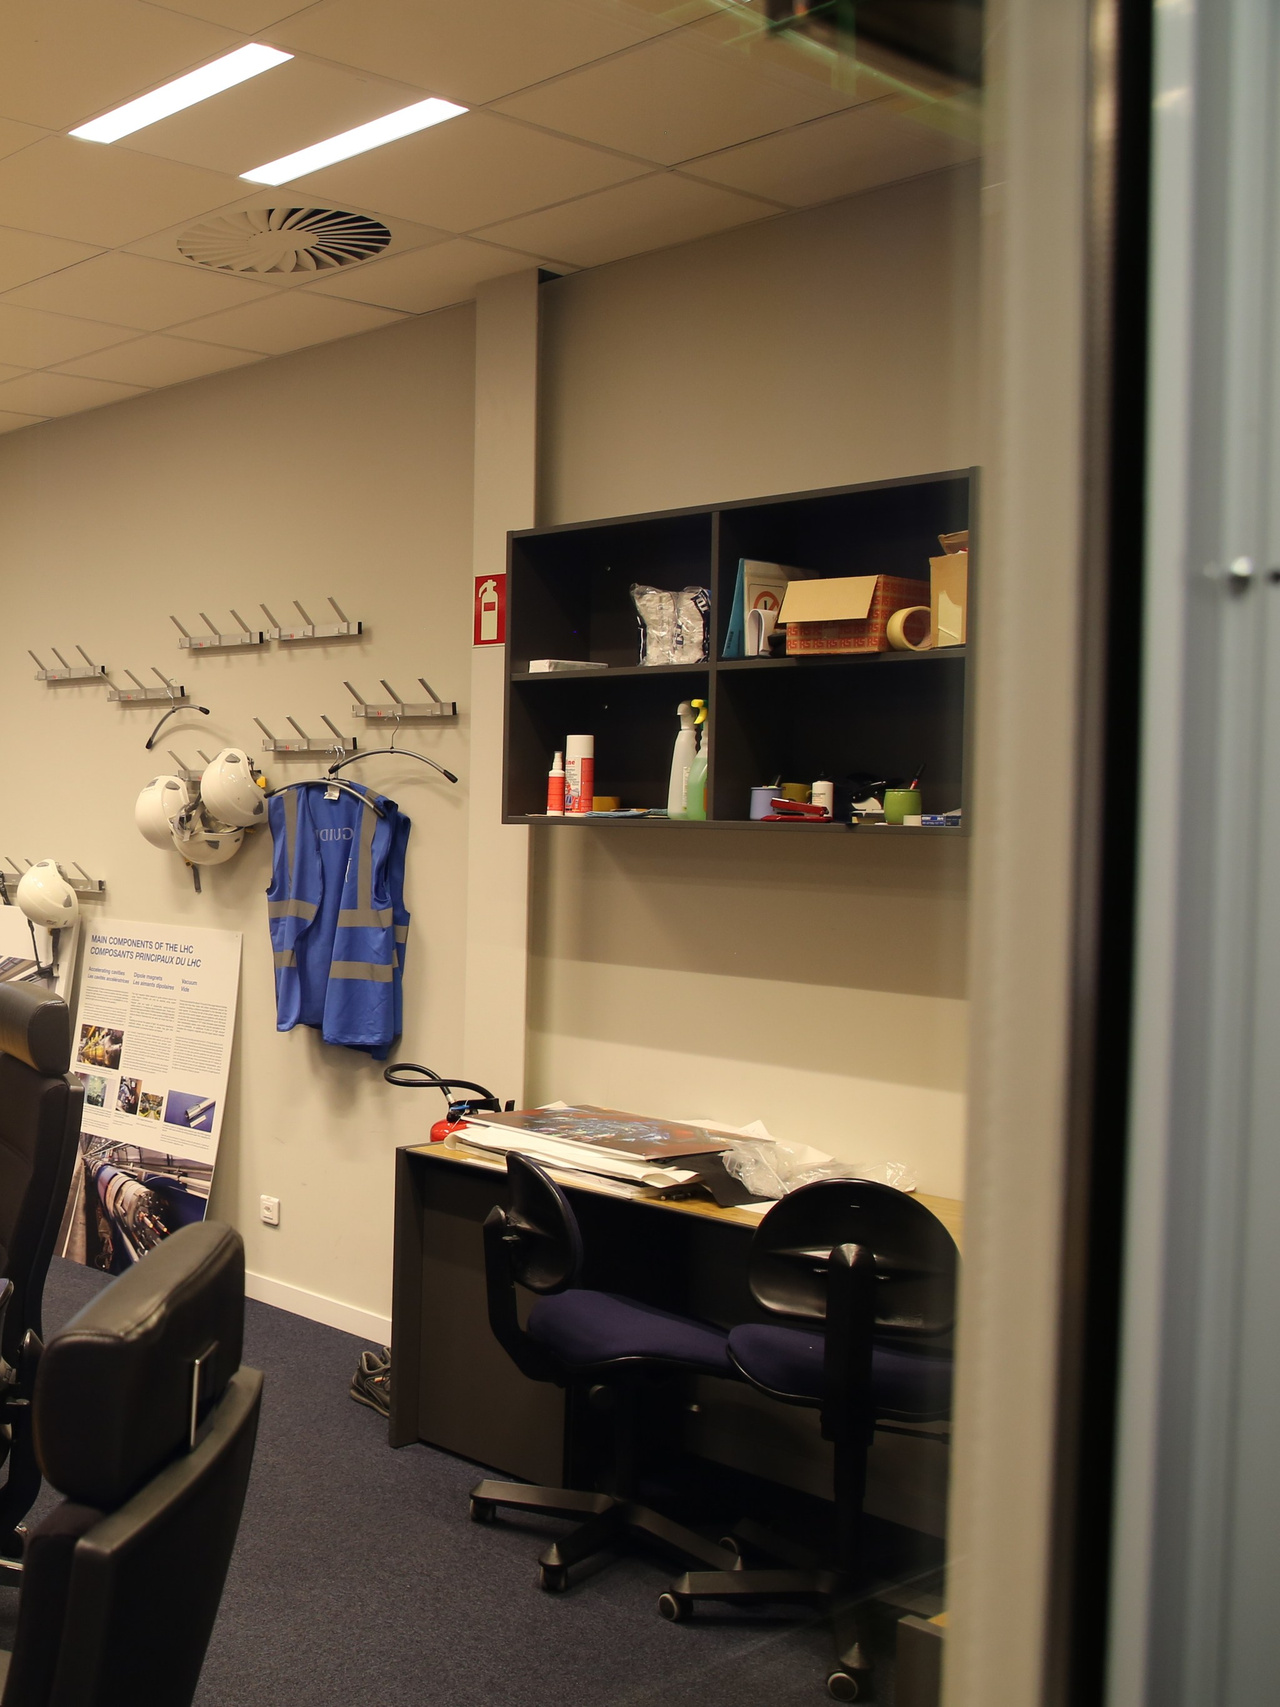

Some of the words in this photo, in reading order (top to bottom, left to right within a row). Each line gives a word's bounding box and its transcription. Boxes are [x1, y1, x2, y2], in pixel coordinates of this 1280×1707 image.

[91, 934, 107, 944] MAIN
[108, 937, 153, 950] COMPONENTS
[154, 941, 164, 951] OF
[165, 942, 179, 953] THE
[180, 944, 194, 955] LHC
[90, 947, 134, 959] COMPOSANTS
[135, 951, 175, 965] PRINCIPAUX
[175, 956, 187, 966] DU
[187, 958, 202, 968] LHC
